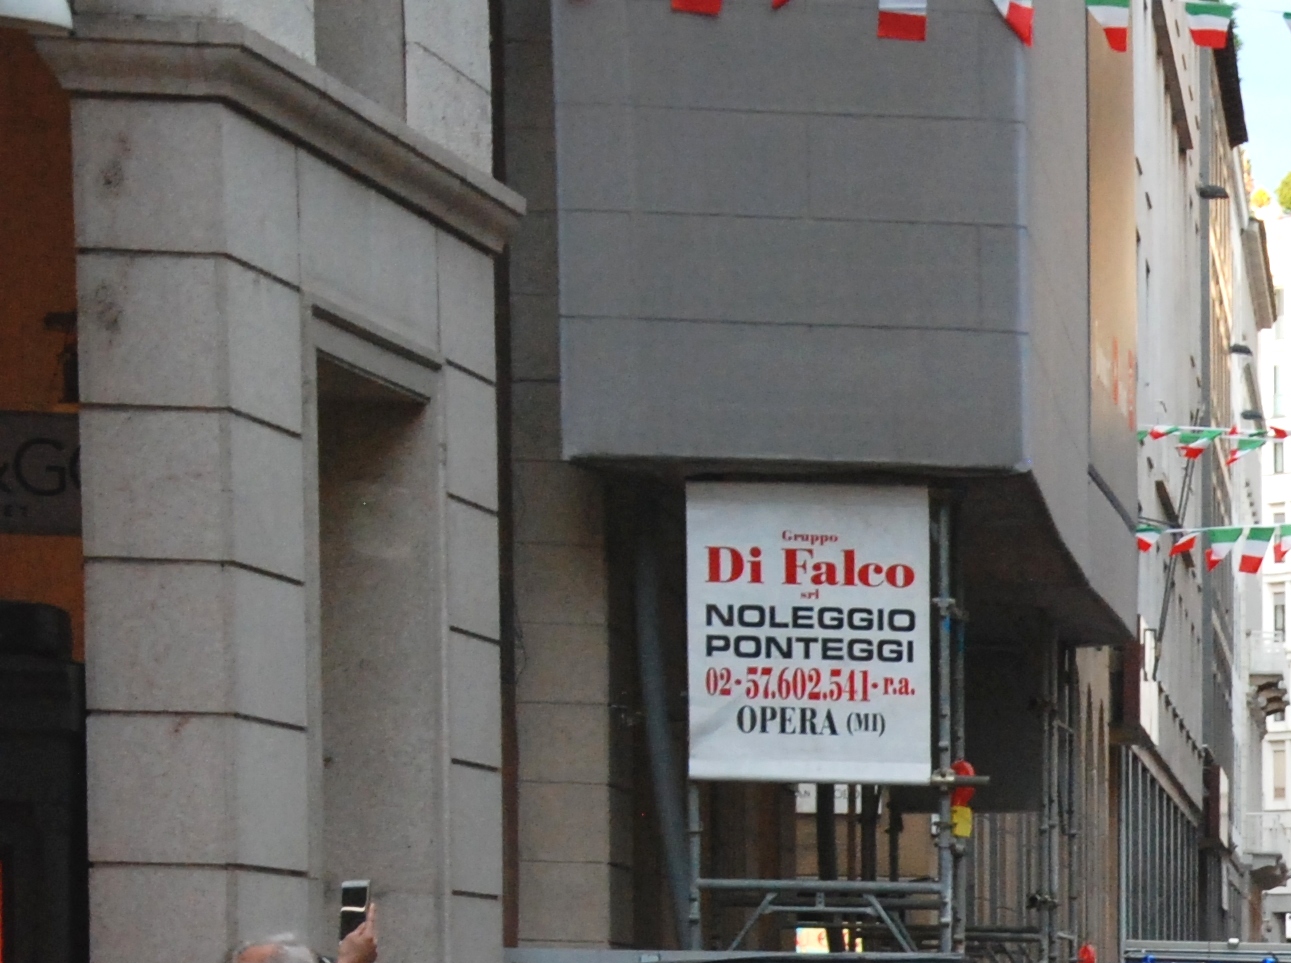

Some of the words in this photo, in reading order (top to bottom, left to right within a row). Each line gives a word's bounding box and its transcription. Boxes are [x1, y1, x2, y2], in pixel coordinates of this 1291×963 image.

[782, 530, 838, 545] Gruppo
[704, 546, 764, 584] Di
[781, 548, 916, 588] Falco
[800, 589, 820, 599] srl
[705, 604, 916, 632] NOLEGGIO
[705, 635, 914, 663] PONTEGGI
[737, 705, 839, 736] OPERA
[846, 711, 886, 737] (MI)
